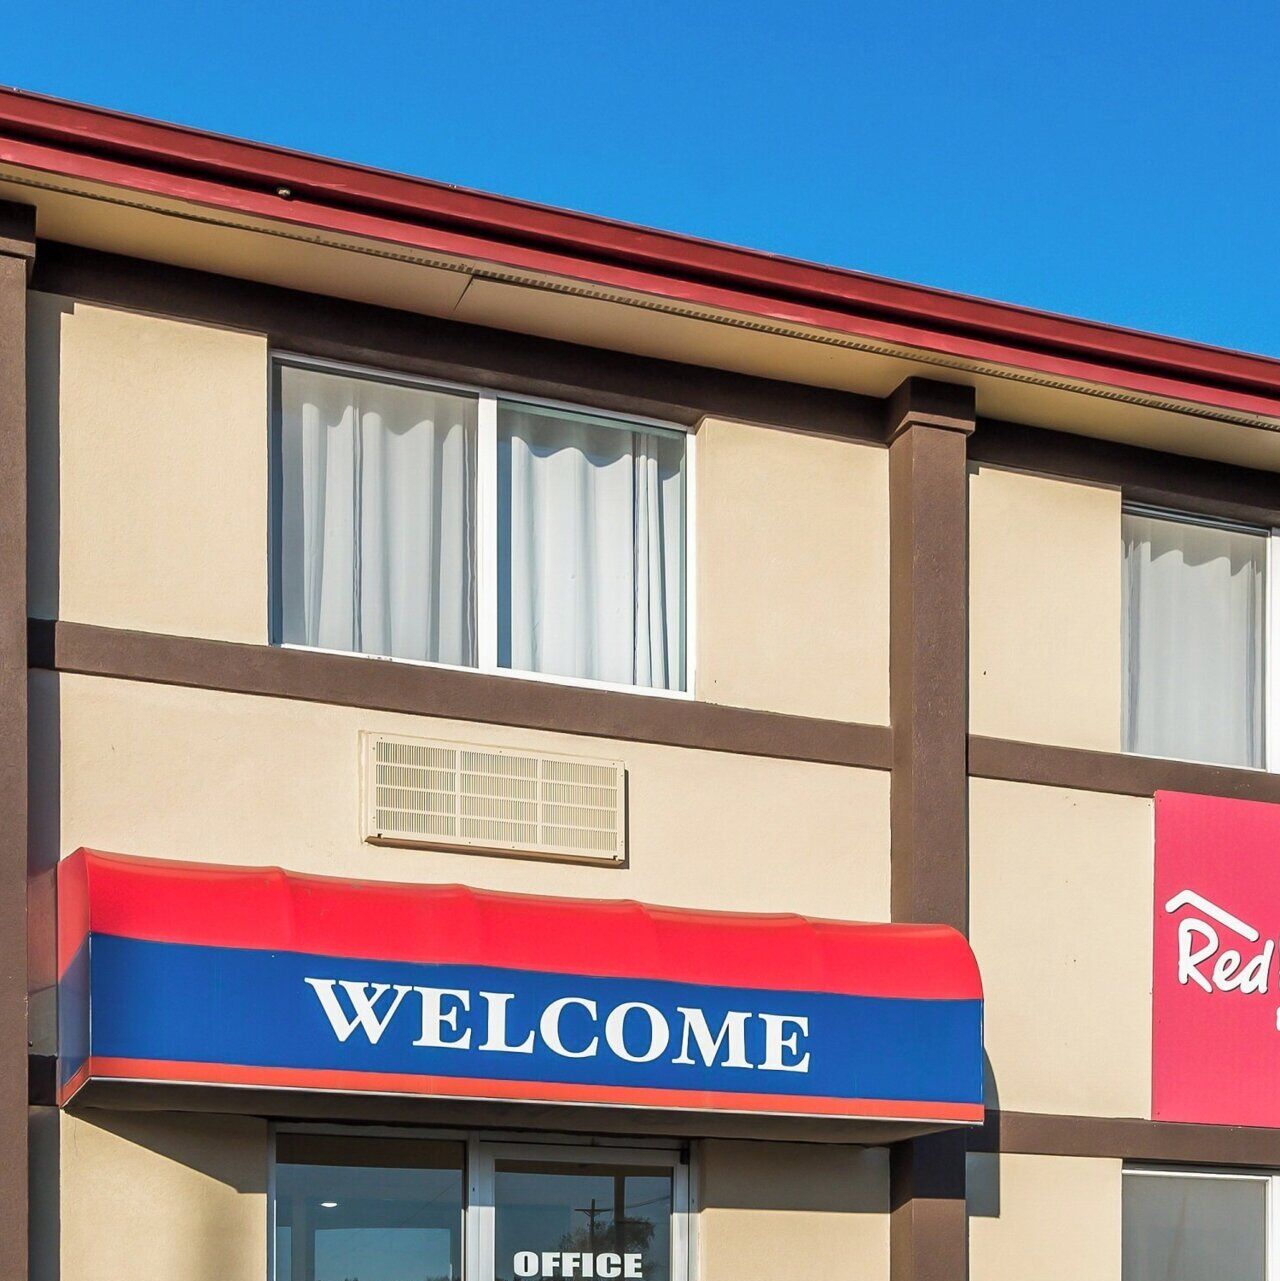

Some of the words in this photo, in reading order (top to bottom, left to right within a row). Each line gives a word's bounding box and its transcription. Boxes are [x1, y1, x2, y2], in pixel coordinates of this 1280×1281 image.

[1178, 918, 1274, 994] Red
[304, 977, 811, 1072] WELCOME
[514, 1251, 642, 1278] OFFICE
